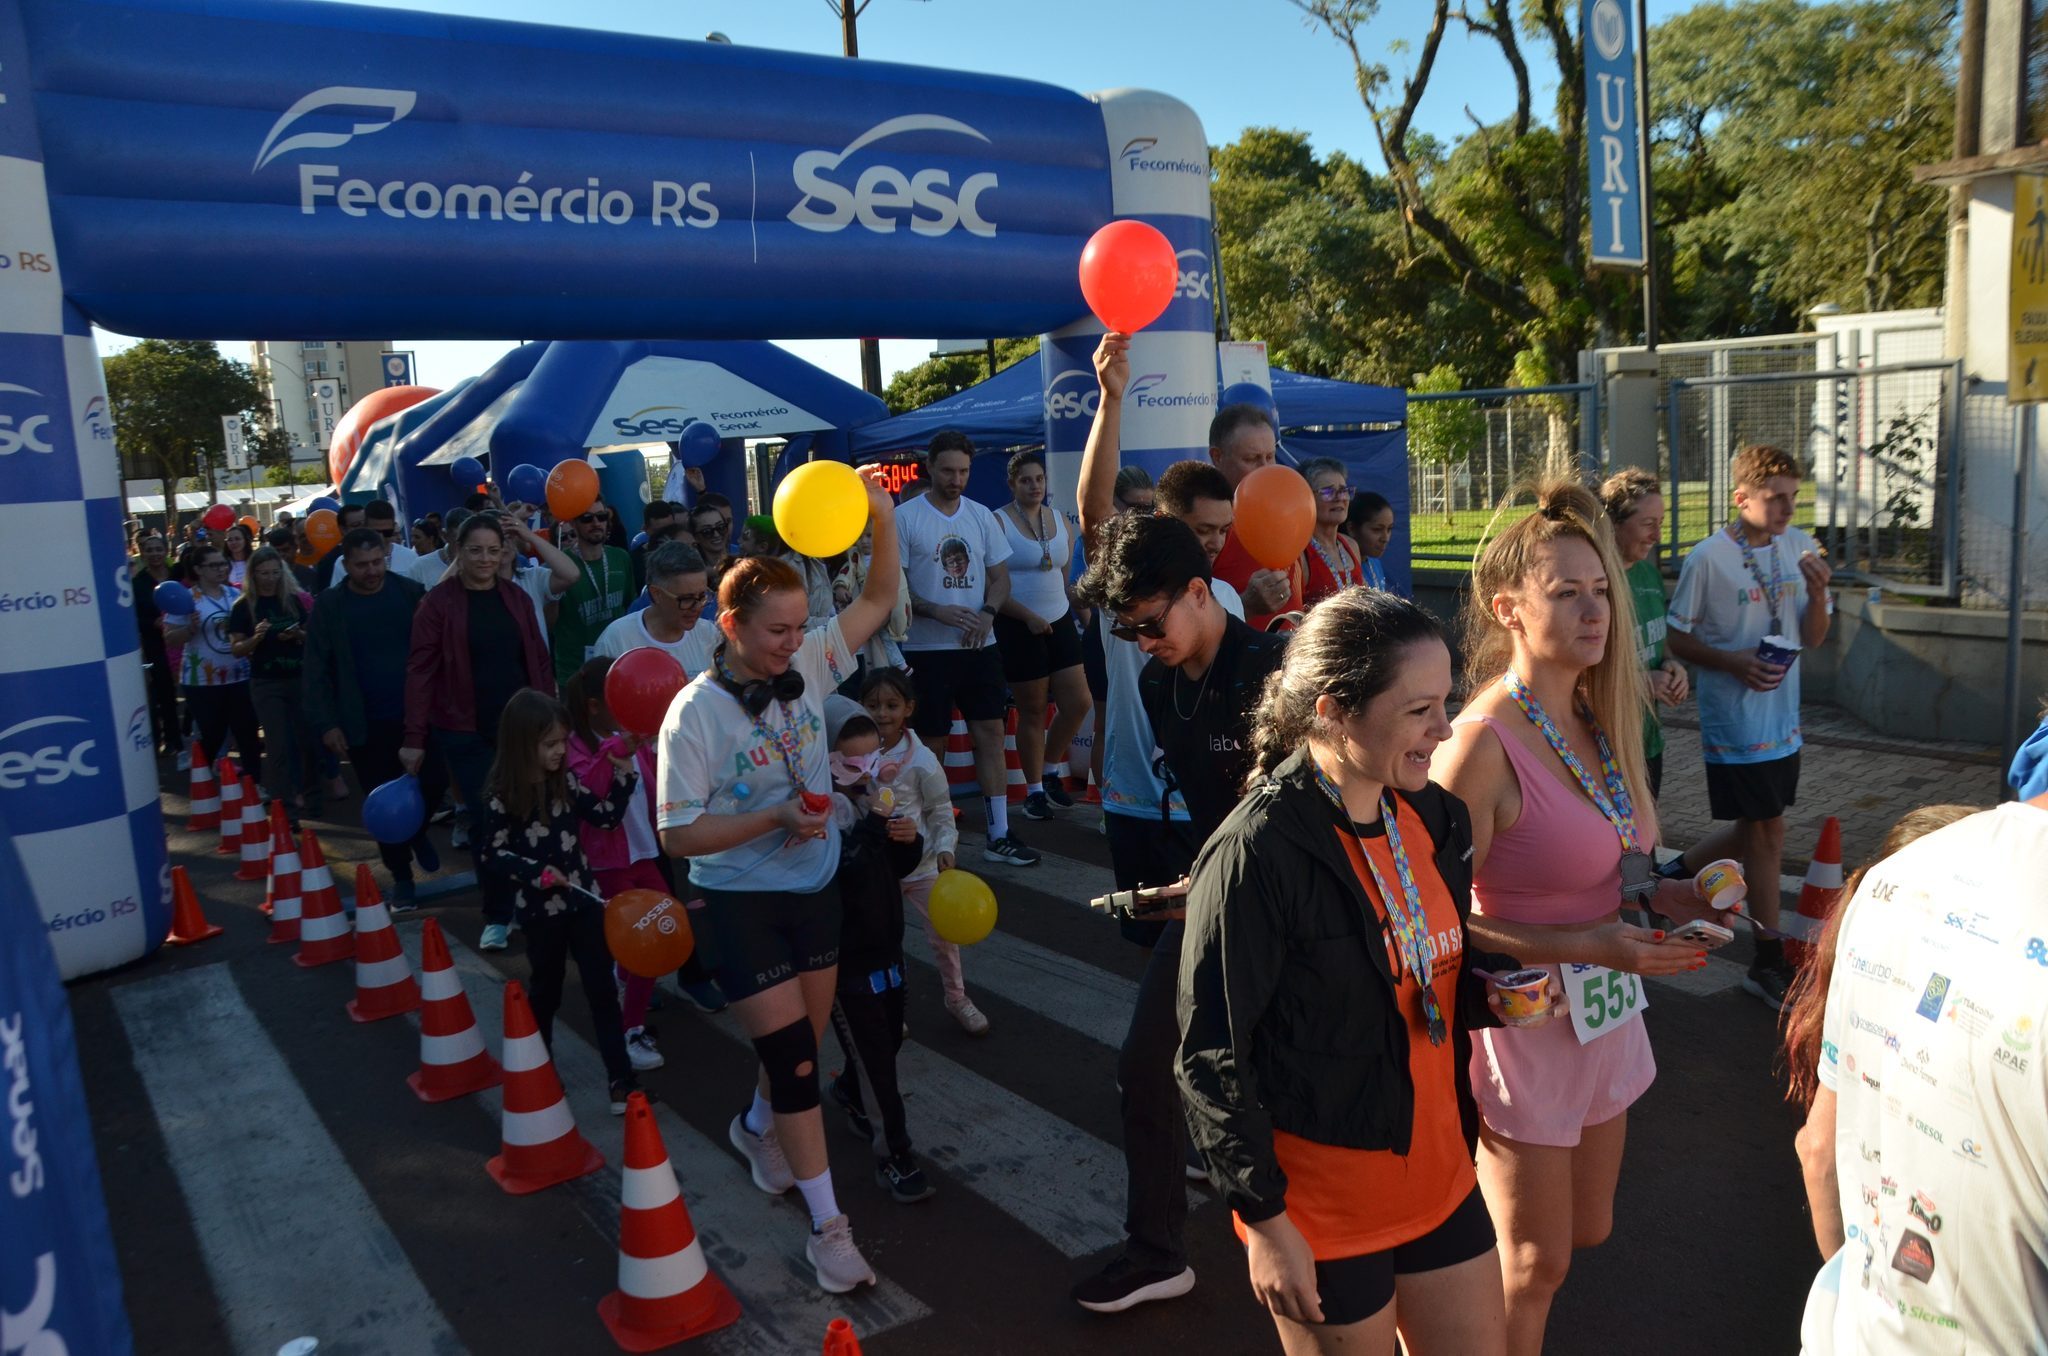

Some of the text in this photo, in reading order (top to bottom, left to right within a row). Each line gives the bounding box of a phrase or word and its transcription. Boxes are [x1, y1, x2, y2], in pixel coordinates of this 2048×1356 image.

[1129, 157, 1201, 175] Fecomércio
[1596, 72, 1629, 254] URI
[300, 163, 720, 228] Fecomércio RS
[787, 148, 998, 238] Sesc
[18, 252, 52, 273] RS
[1176, 268, 1210, 300] esc
[1137, 392, 1210, 408] Fecomércio
[711, 406, 789, 422] Fecomércio
[943, 576, 973, 589] GAEL
[0, 592, 57, 613] ércio
[63, 586, 92, 607] RS
[0, 738, 99, 789] esc
[50, 894, 137, 932] ércio RS
[755, 961, 793, 985] RUN
[1993, 1046, 2029, 1072] APAE
[1915, 1118, 1944, 1145] CRESOL
